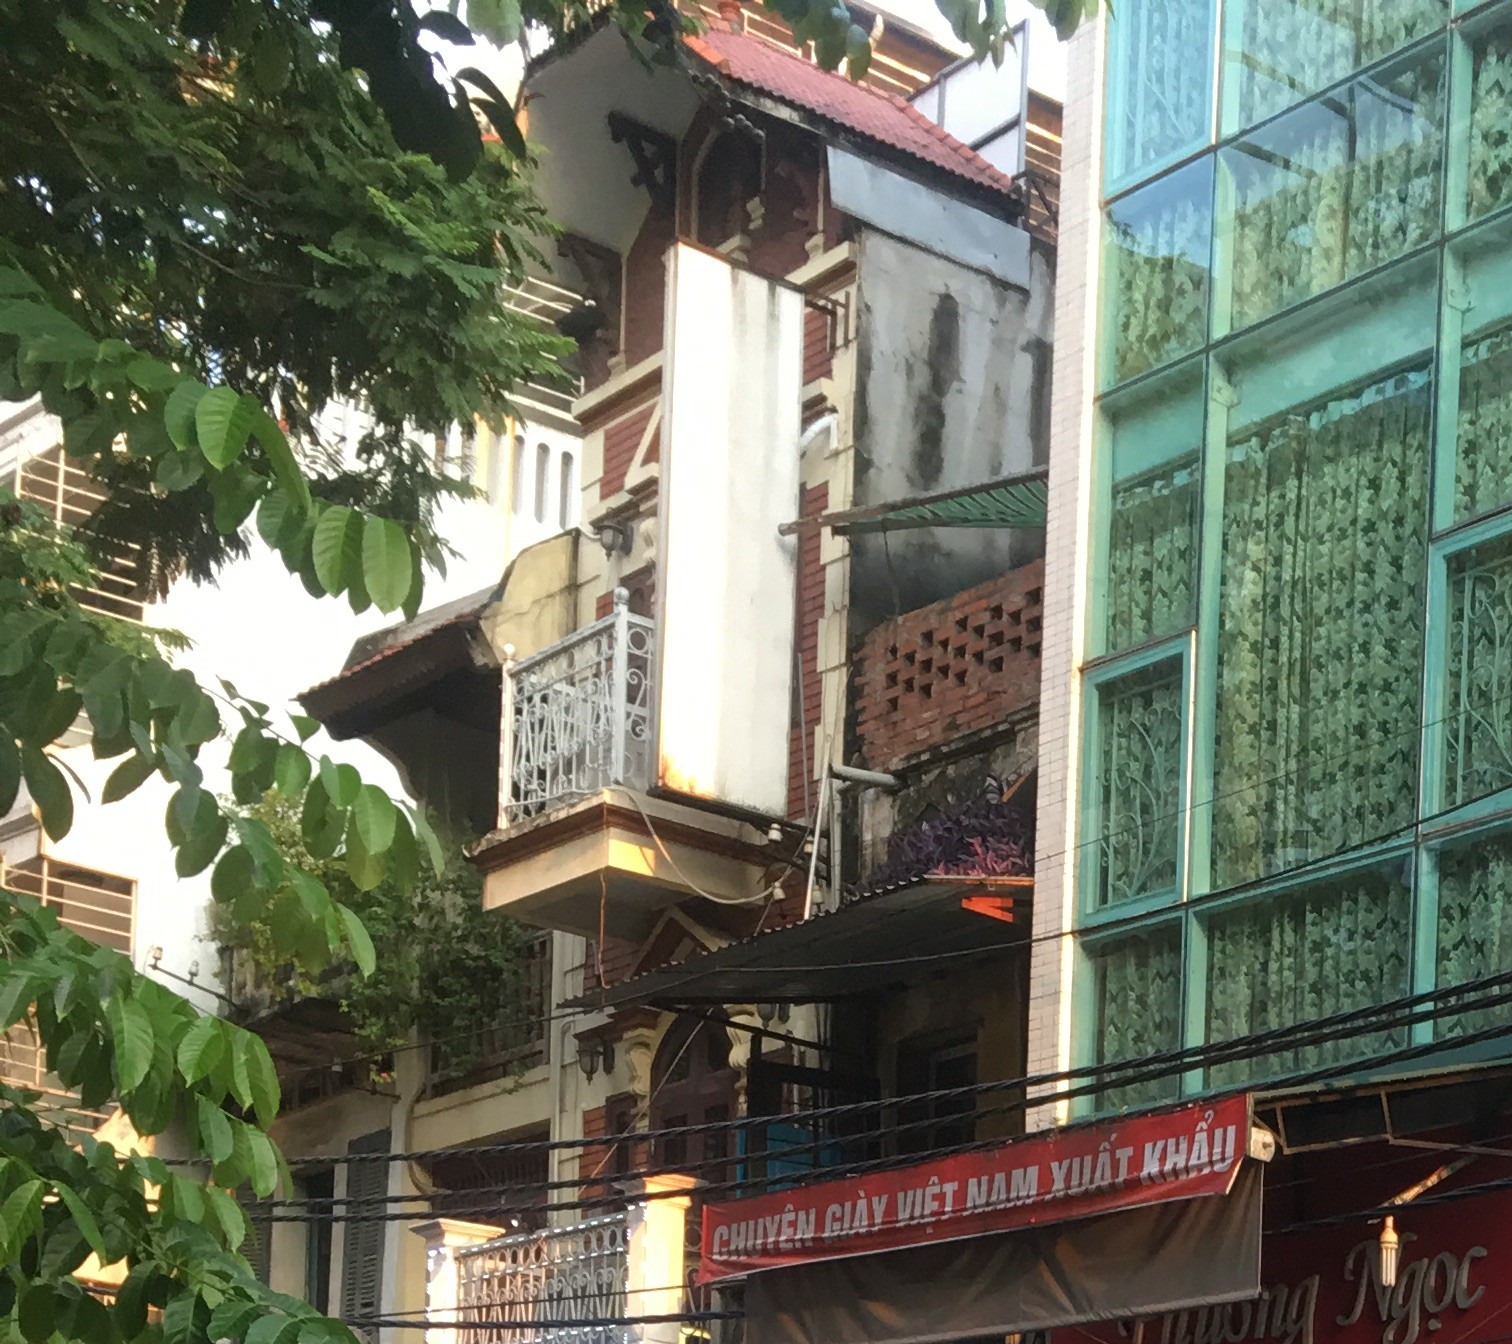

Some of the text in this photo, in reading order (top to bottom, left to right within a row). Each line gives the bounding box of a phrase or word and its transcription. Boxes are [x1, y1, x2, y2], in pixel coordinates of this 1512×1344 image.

[712, 1110, 1237, 1262] CHUYÊN GIÀY VIỆT NAM XUẤT KHẨU
